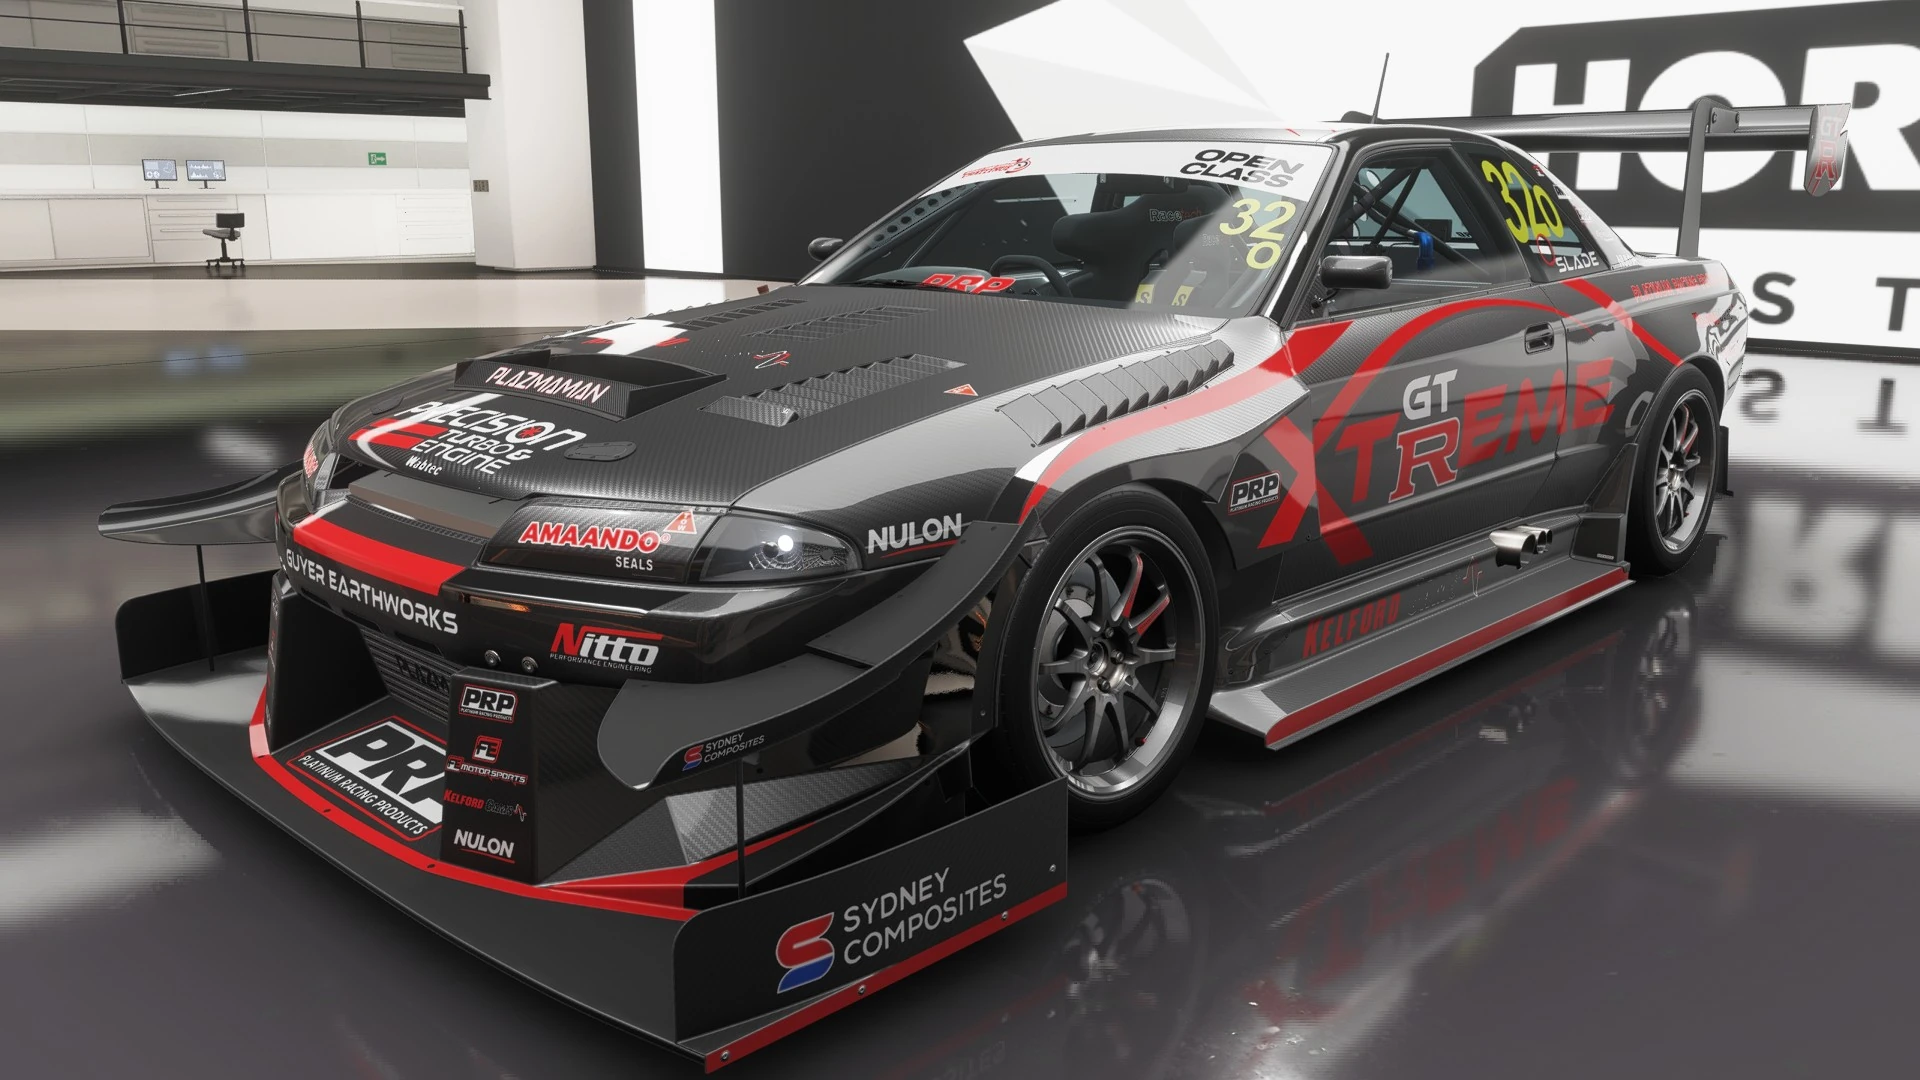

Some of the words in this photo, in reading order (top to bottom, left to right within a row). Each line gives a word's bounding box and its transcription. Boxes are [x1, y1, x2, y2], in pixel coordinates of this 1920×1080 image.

[1179, 162, 1294, 188] CLASS
[1194, 149, 1304, 175] OPEN
[1219, 198, 1297, 241] 32
[1555, 251, 1600, 273] SLADE
[922, 273, 1017, 294] PRP
[485, 366, 611, 404] PLAZMAMAN
[1403, 368, 1458, 421] GT
[436, 429, 511, 455] TURBO
[1257, 345, 1614, 567] XTREME
[405, 455, 443, 477] Wabtec
[1232, 474, 1279, 505] PRP
[867, 512, 962, 555] NULON
[615, 555, 654, 571] SEALS
[285, 548, 326, 587] GUYER
[328, 569, 459, 635] EARTHWORKS
[1302, 592, 1400, 660] KELFORD
[550, 622, 662, 667] Nitto
[549, 652, 602, 667] PERFORMANCE
[603, 661, 653, 675] ENGINEERING
[463, 688, 515, 713] PRP
[704, 735, 765, 763] COMPOSITES
[705, 732, 744, 753] SYDNEY
[460, 763, 527, 784] MOTORSPORTS
[298, 754, 344, 784] PLATINUM
[339, 777, 378, 805] RACING
[371, 799, 430, 836] PRODUCTS
[453, 828, 515, 859] NULON
[843, 867, 950, 932] SYDNEY
[843, 873, 1007, 965] COMPOSITES
